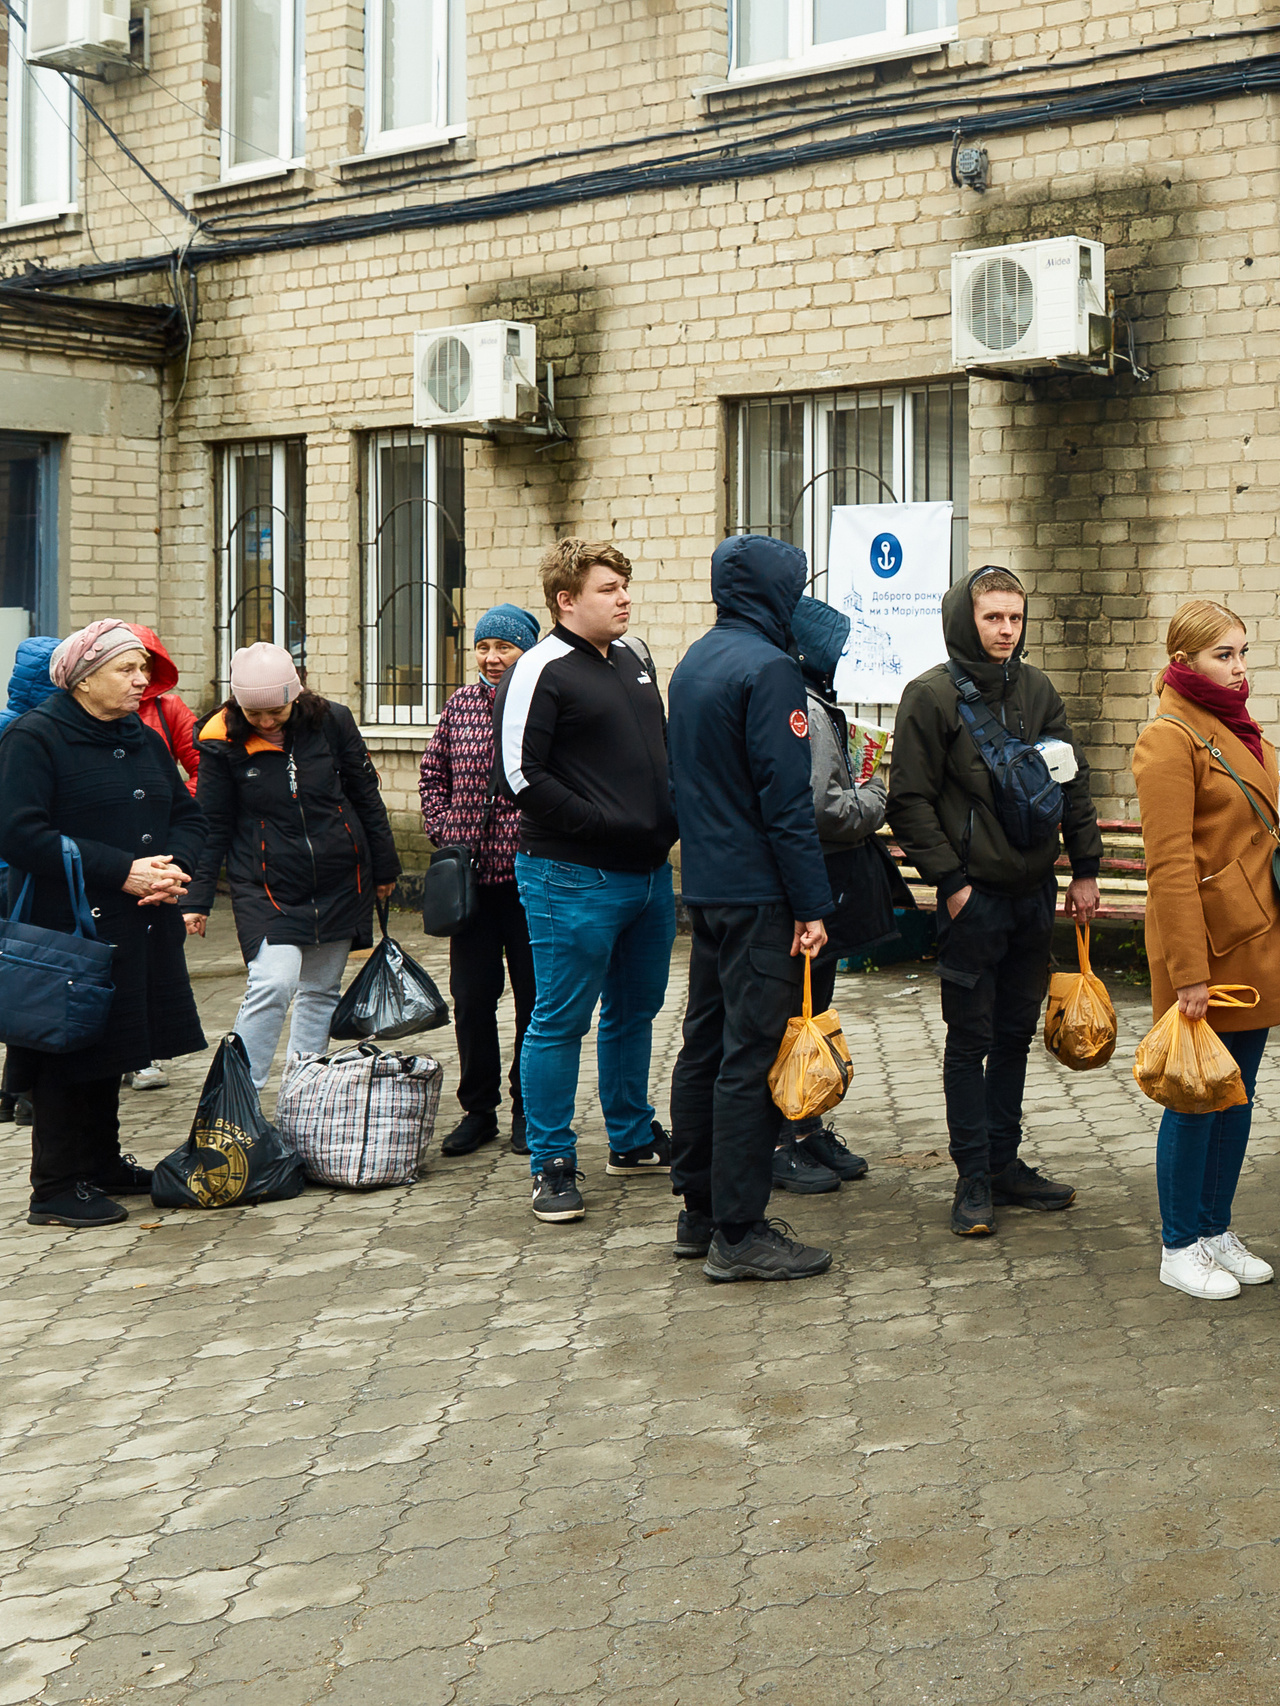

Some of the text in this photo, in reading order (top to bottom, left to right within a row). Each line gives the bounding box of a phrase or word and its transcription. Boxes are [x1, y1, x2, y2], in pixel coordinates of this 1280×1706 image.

[783, 151, 799, 219] Saturn
[1046, 257, 1071, 268] Midea
[872, 591, 943, 602] Доброго ранку
[892, 606, 942, 616] Маріуполя
